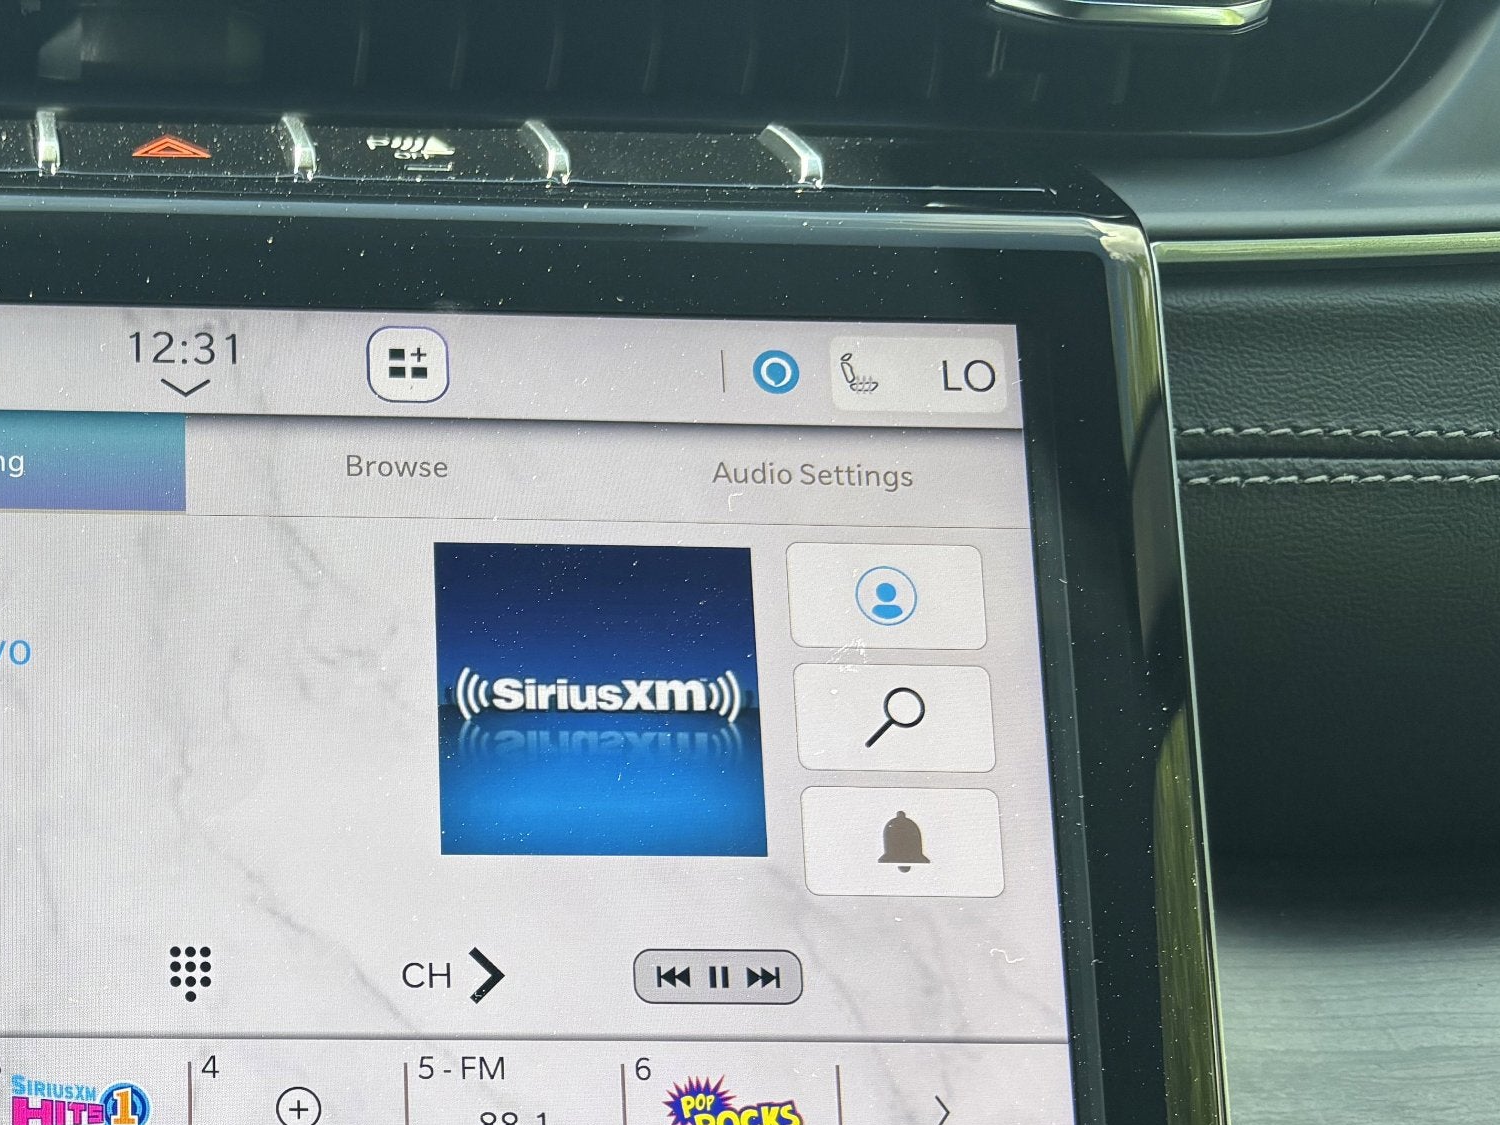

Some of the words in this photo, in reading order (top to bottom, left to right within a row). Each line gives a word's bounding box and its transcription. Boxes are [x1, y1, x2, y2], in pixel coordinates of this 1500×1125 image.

[127, 330, 242, 367] 12:31
[943, 358, 996, 393] LO
[345, 454, 449, 479] Browse
[712, 461, 792, 486] Audio
[800, 461, 914, 494] Settings
[402, 961, 452, 989] CH
[200, 1054, 220, 1079] 4
[418, 1056, 434, 1080] 5
[463, 1056, 506, 1080] FM
[635, 1057, 652, 1081] 6
[681, 1093, 716, 1118] POP
